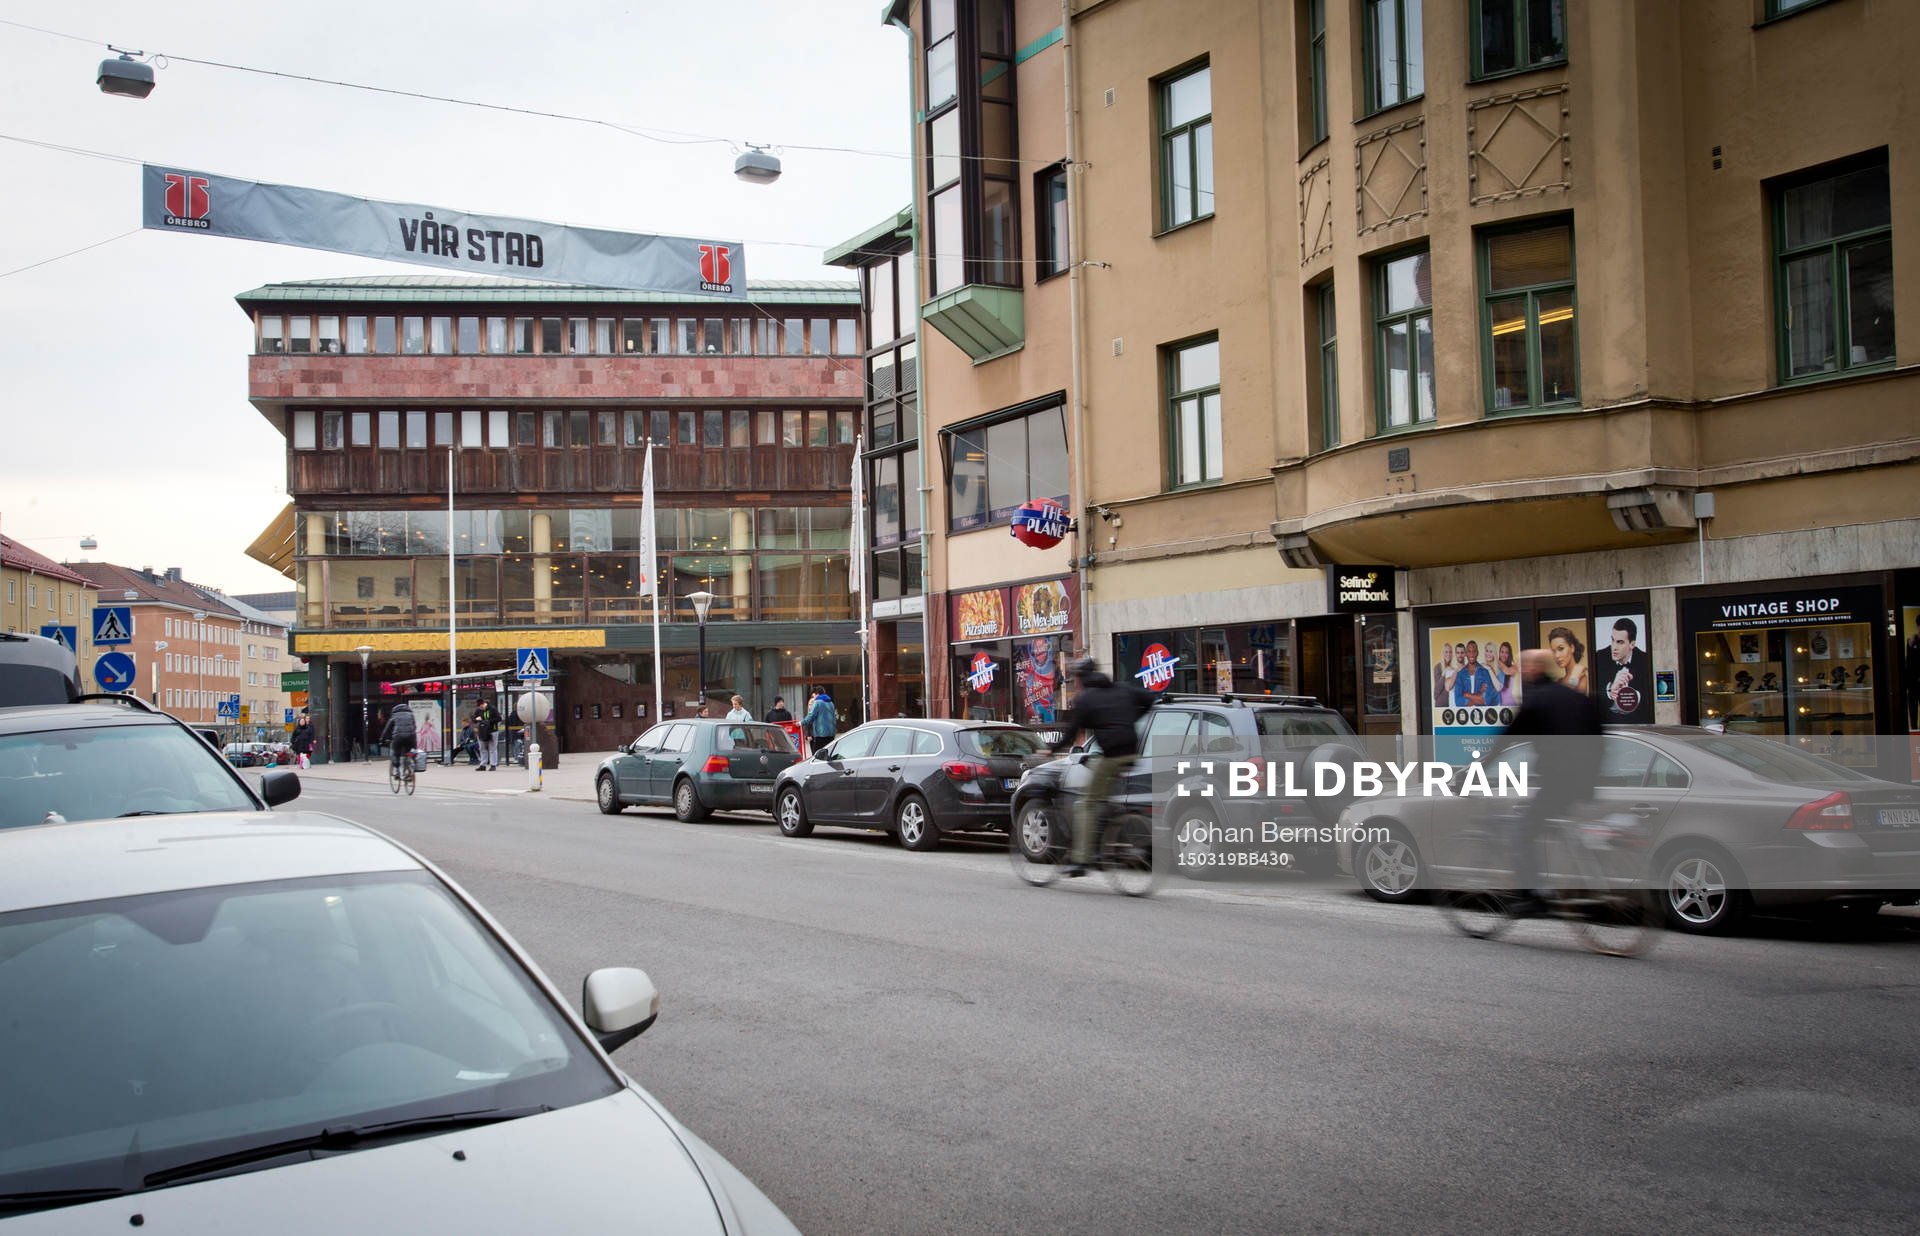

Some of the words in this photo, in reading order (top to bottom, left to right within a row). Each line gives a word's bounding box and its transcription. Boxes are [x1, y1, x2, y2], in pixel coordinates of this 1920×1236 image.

[167, 216, 208, 228] ÖREBRO
[399, 211, 460, 259] VÅR
[467, 228, 544, 268] STAD
[702, 282, 731, 292] ÖREBRO
[1042, 503, 1063, 522] THE
[1340, 576, 1372, 588] Sefina
[1340, 590, 1389, 604] pantbank
[1721, 601, 1789, 618] VINTAGE
[1796, 598, 1840, 613] SHOP
[1019, 615, 1032, 629] Tex
[975, 657, 987, 674] THE
[1146, 649, 1164, 669] THE
[972, 670, 994, 690] PLANET
[1142, 662, 1175, 688] PLANET
